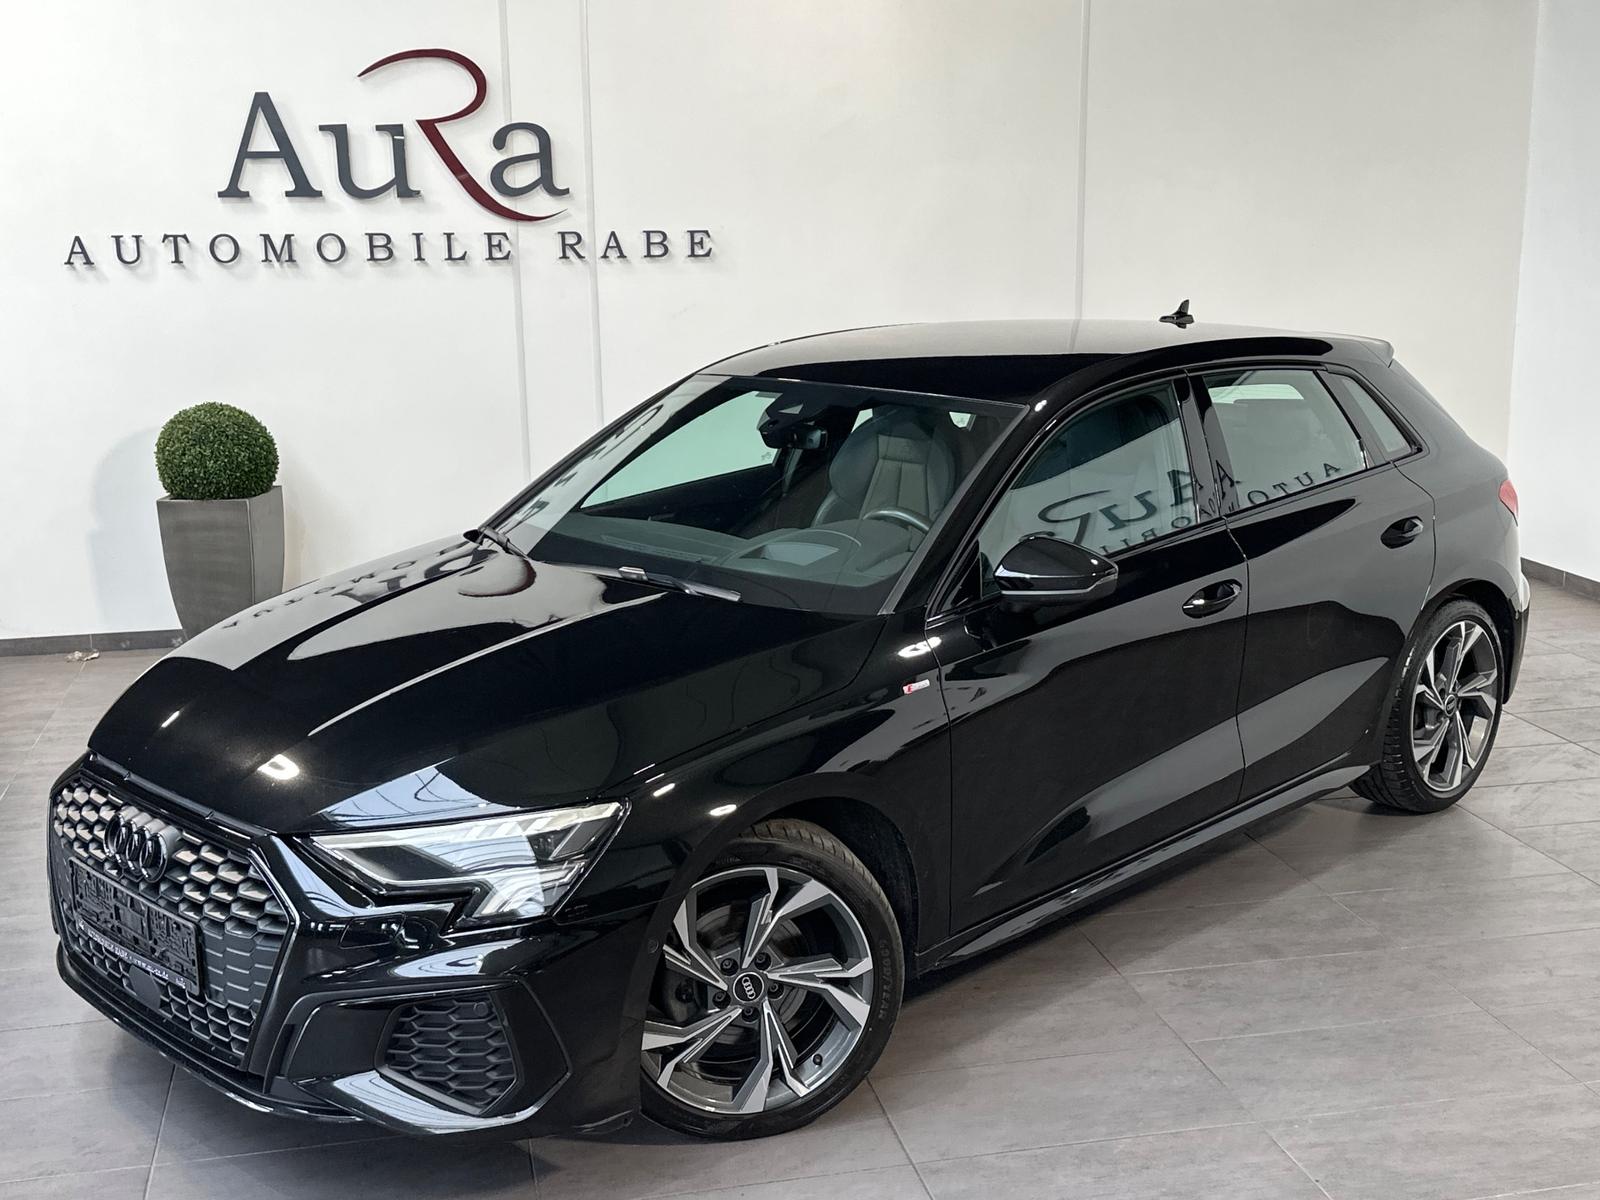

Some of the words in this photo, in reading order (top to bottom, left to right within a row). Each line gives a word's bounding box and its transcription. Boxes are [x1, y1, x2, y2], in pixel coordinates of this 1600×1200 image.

[217, 48, 570, 223] AuRa
[64, 232, 511, 267] AUTOMOBILE
[557, 229, 713, 260] RABE
